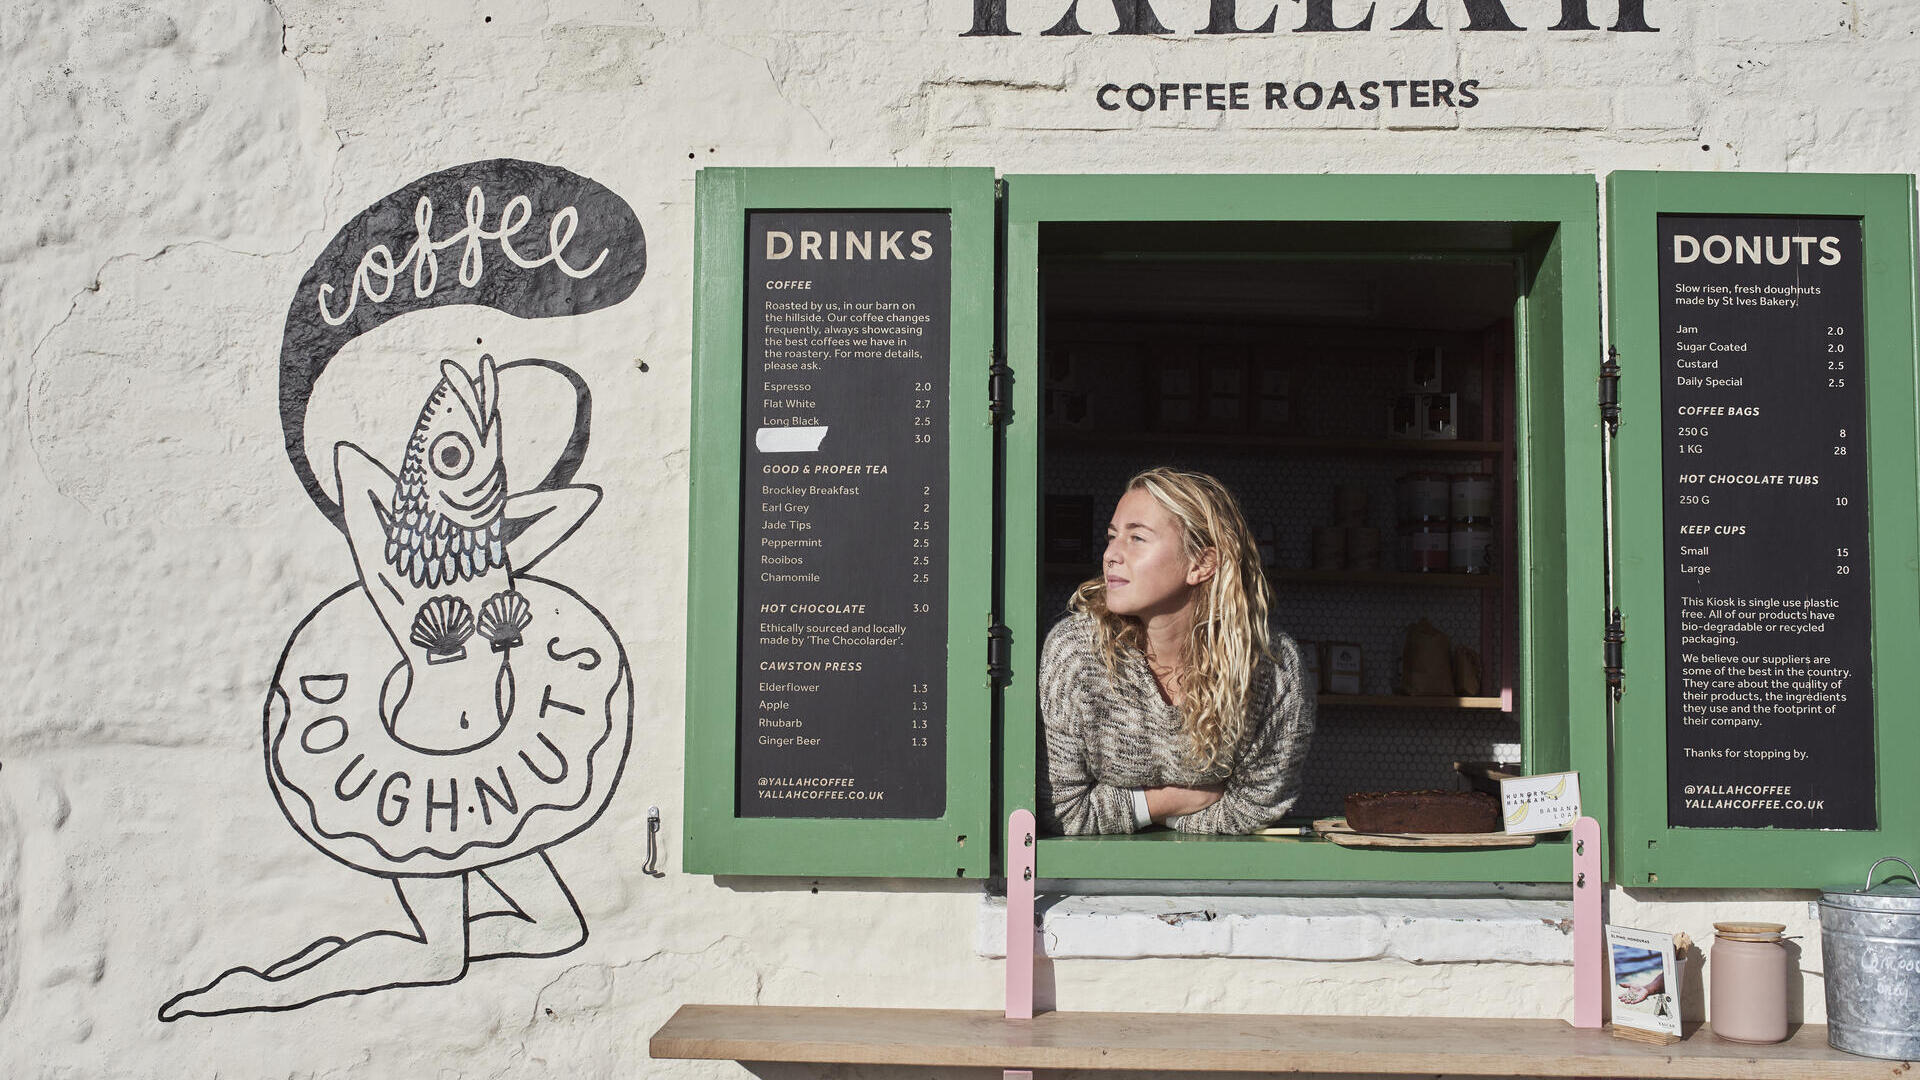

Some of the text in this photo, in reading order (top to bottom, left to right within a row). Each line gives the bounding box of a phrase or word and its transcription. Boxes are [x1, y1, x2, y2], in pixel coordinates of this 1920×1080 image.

[1096, 79, 1480, 112] COFFEE ROASTERS
[766, 230, 933, 261] DRINKS
[1674, 234, 1841, 266] DONUTS
[318, 186, 609, 326] coffee
[766, 280, 812, 290] COFFEE
[1675, 284, 1821, 297] Slow risen, fresh doughnuts
[765, 301, 808, 310] Roasted
[825, 303, 841, 311] us,
[876, 301, 899, 310] barn
[1675, 296, 1799, 309] made Ives Bakery.
[765, 313, 930, 324] the hillside. Our coffee changes
[765, 325, 922, 336] frequently, always showcasing
[1676, 324, 1844, 336] Jam 2.0
[765, 337, 895, 346] the best coffees have
[1676, 341, 1844, 354] Sugar Coated 2.0
[765, 349, 782, 358] the
[785, 350, 831, 360] roastery.
[835, 349, 852, 358] For
[884, 349, 922, 359] details,
[764, 361, 821, 372] please ask.
[1676, 359, 1844, 370] Custard 2.5
[764, 382, 931, 393] Espresso 2.0
[1677, 376, 1845, 388] Daily Special 2.5
[764, 399, 930, 408] Flat White 2.7
[1678, 406, 1760, 416] COFFEE BAGS
[763, 416, 930, 426] Long Black 2.5
[1678, 427, 1698, 436] 250
[914, 434, 931, 443] 3.0
[1834, 446, 1847, 456] 28
[763, 465, 888, 474] GOOD PROPER TEA
[1679, 474, 1819, 485] HOT CHOCOLATE TUBS
[762, 485, 859, 497] Brockley Breakfast
[1680, 495, 1848, 506] 250 10
[762, 502, 809, 514] Earl Grey
[762, 520, 929, 531] Jade Tips 2.5
[1680, 525, 1746, 535] KEEP CUPS
[761, 537, 929, 549] Peppermint 2.5
[1680, 545, 1849, 557] Small 15
[761, 555, 929, 565] Rooibos 2.5
[1681, 563, 1850, 576] Large 20
[761, 572, 929, 583] Chamomile 2.5
[760, 603, 929, 614] HOT CHOCOLATE 3.0
[1681, 596, 1839, 610] This Kiosk single plastic
[1681, 609, 1835, 621] free. All products have
[760, 623, 906, 636] Ethically sourced and locally
[1681, 622, 1825, 634] bio-degradable recycled
[760, 635, 789, 645] made
[1682, 634, 1739, 646] packaging.
[1701, 653, 1811, 666] believe suppliers
[760, 661, 862, 671] CAWSTON PRESS
[1682, 667, 1852, 679] some best country.
[759, 682, 928, 693] Elderflower 1.3
[1682, 678, 1828, 691] They care about quality
[1682, 691, 1847, 704] their products, ingredients
[759, 700, 928, 711] Apple 1.3
[1683, 703, 1822, 716] they footprint
[759, 718, 927, 729] Rhubarb 1.3
[1683, 716, 1763, 728] their company.
[758, 735, 927, 747] Ginger Beer 1.3
[1683, 748, 1809, 761] Thanks for stopping by.
[758, 777, 855, 787] @YALLAHCOFFEE
[758, 790, 884, 800] YALLAHCOFFEE.CO.UK
[1684, 785, 1791, 795] @YALLAHCOFFEE
[1685, 799, 1825, 810] YALLAHCOFFEE.CO.UK
